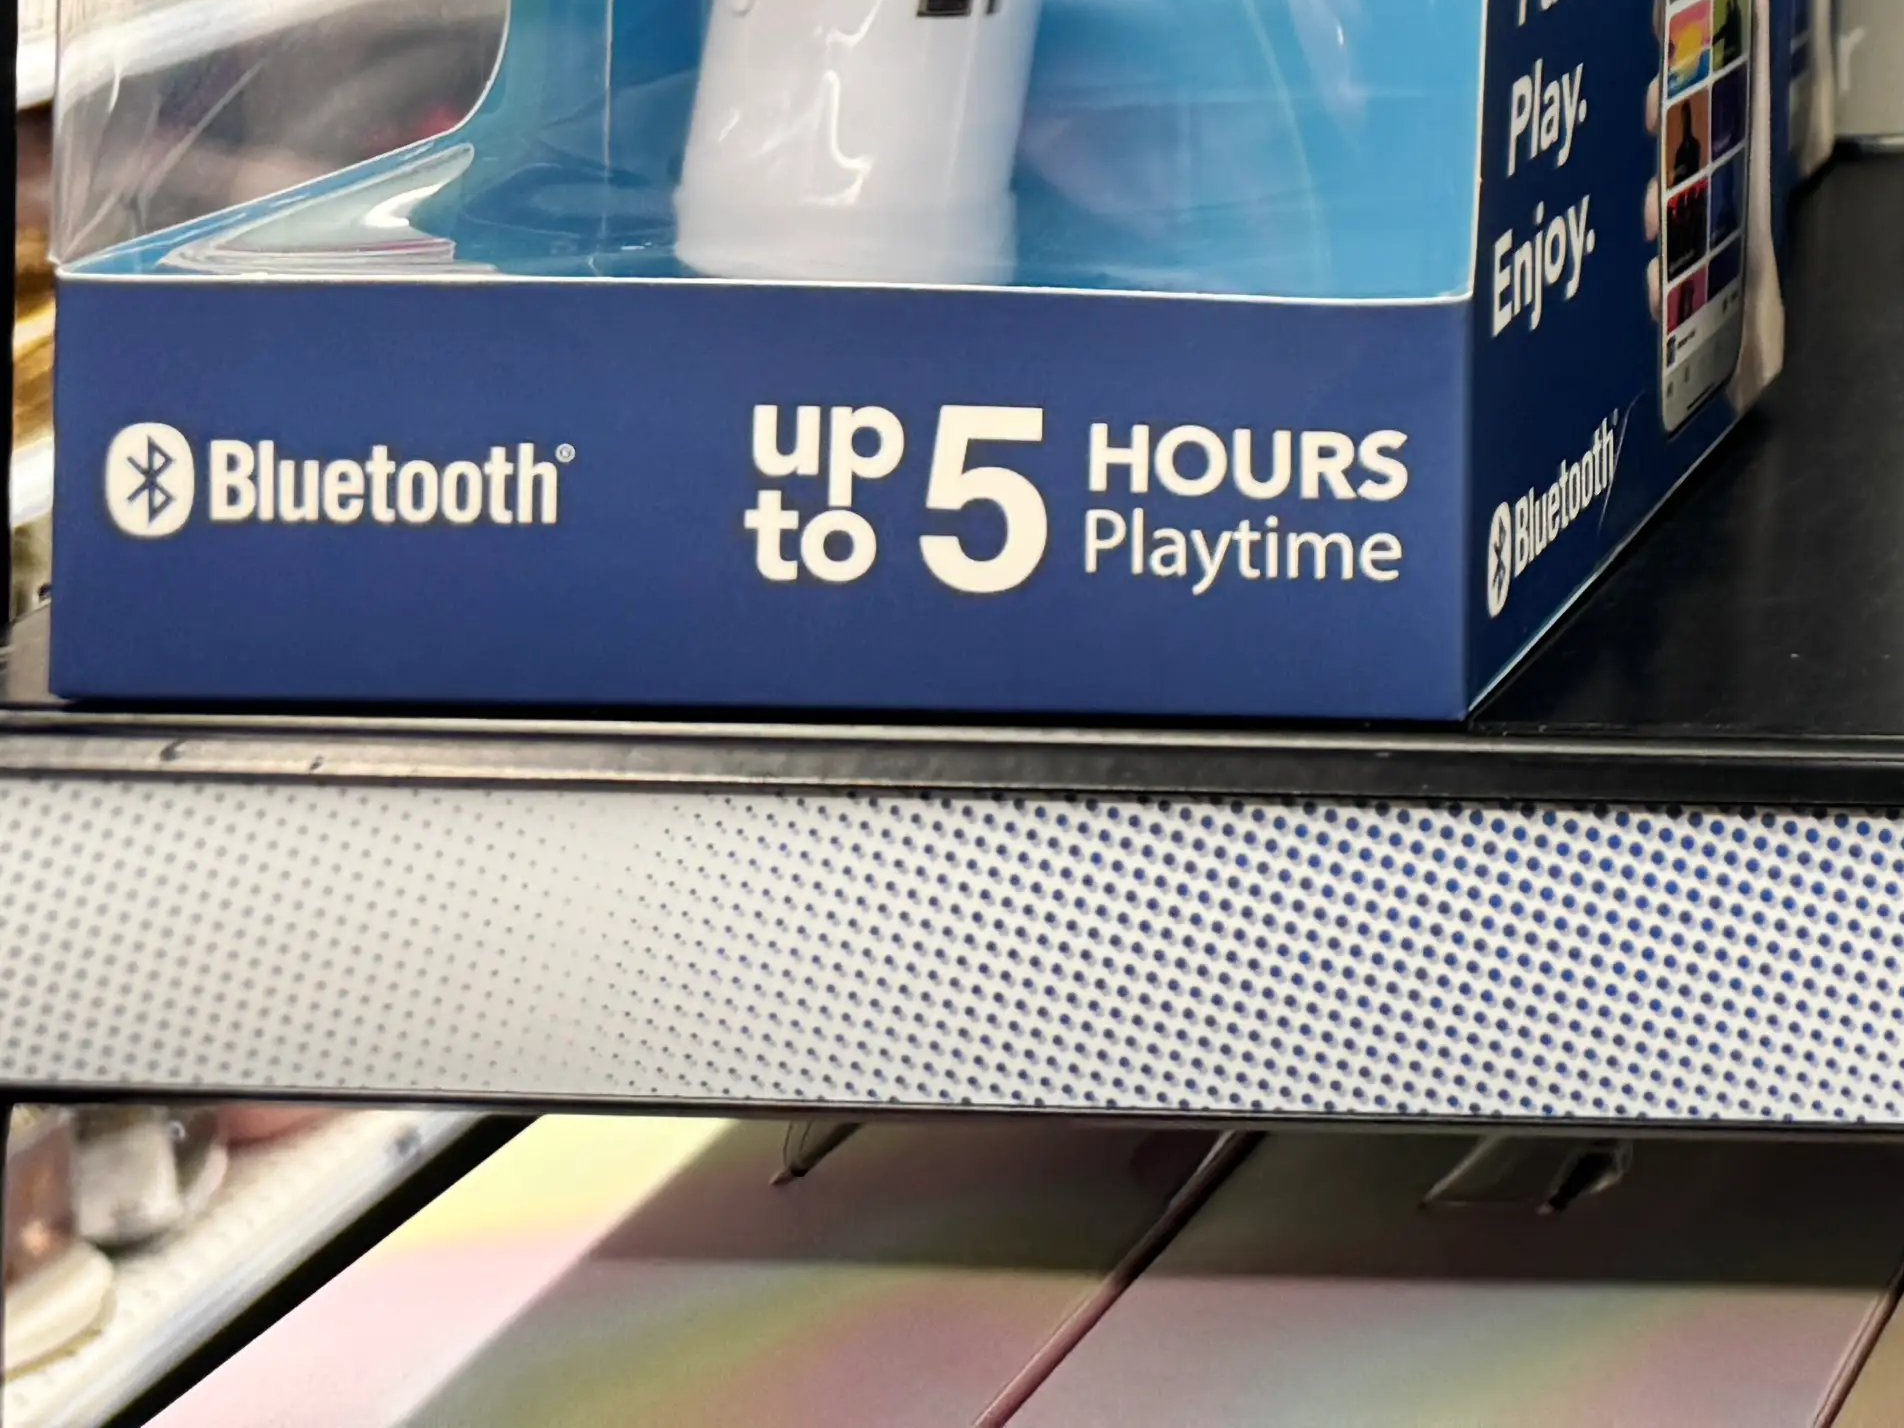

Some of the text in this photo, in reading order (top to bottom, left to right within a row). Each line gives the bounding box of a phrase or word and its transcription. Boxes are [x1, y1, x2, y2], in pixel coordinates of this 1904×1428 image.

[1507, 58, 1588, 178] Play.
[1491, 193, 1596, 339] Enjoy.
[751, 403, 905, 491] up
[1089, 423, 1408, 505] HOURS
[744, 491, 877, 583] to
[919, 405, 1047, 595] 5
[1083, 508, 1402, 596] Playtime
